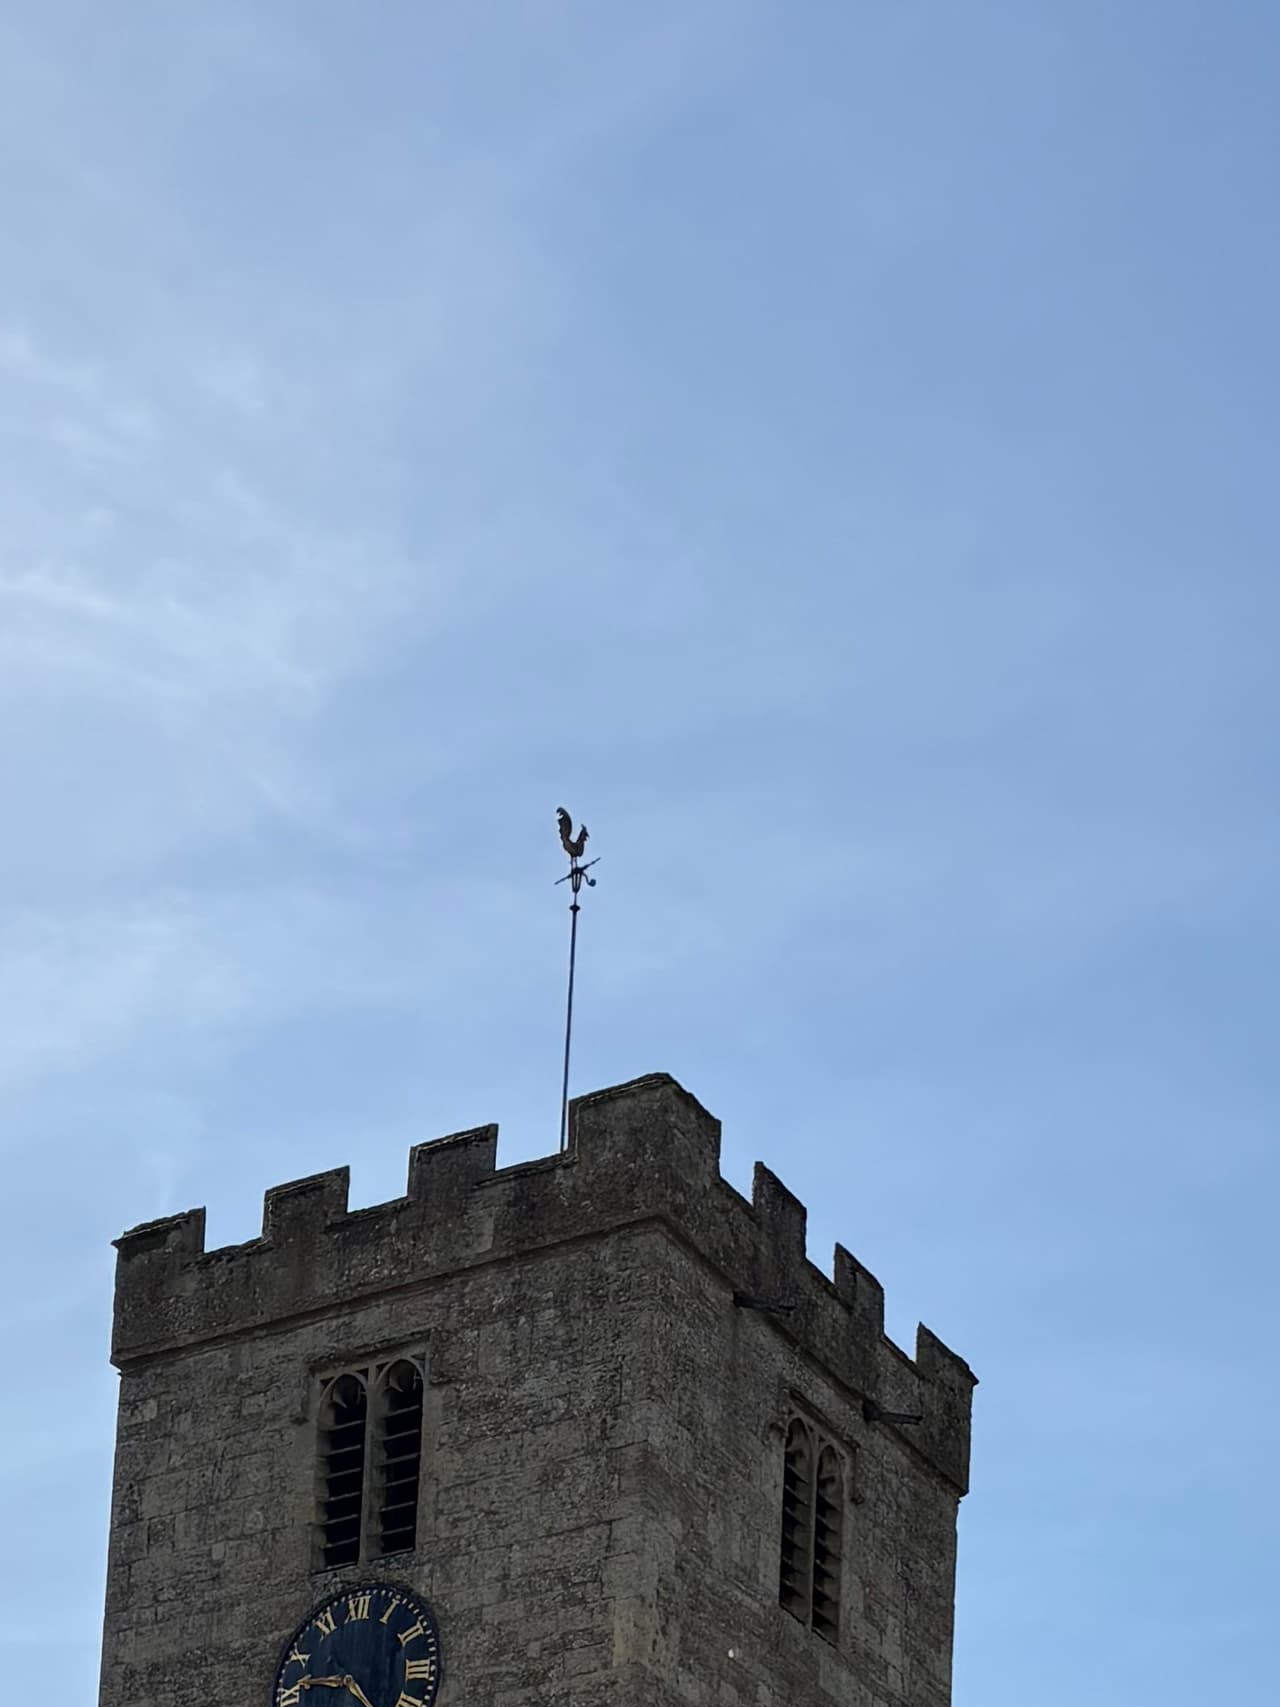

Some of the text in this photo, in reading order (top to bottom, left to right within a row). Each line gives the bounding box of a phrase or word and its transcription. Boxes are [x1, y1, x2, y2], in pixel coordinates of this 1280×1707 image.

[344, 1594, 372, 1625] XII
[379, 1598, 400, 1625] I
[397, 1622, 424, 1647] II
[290, 1647, 311, 1669] X
[405, 1658, 431, 1680] III
